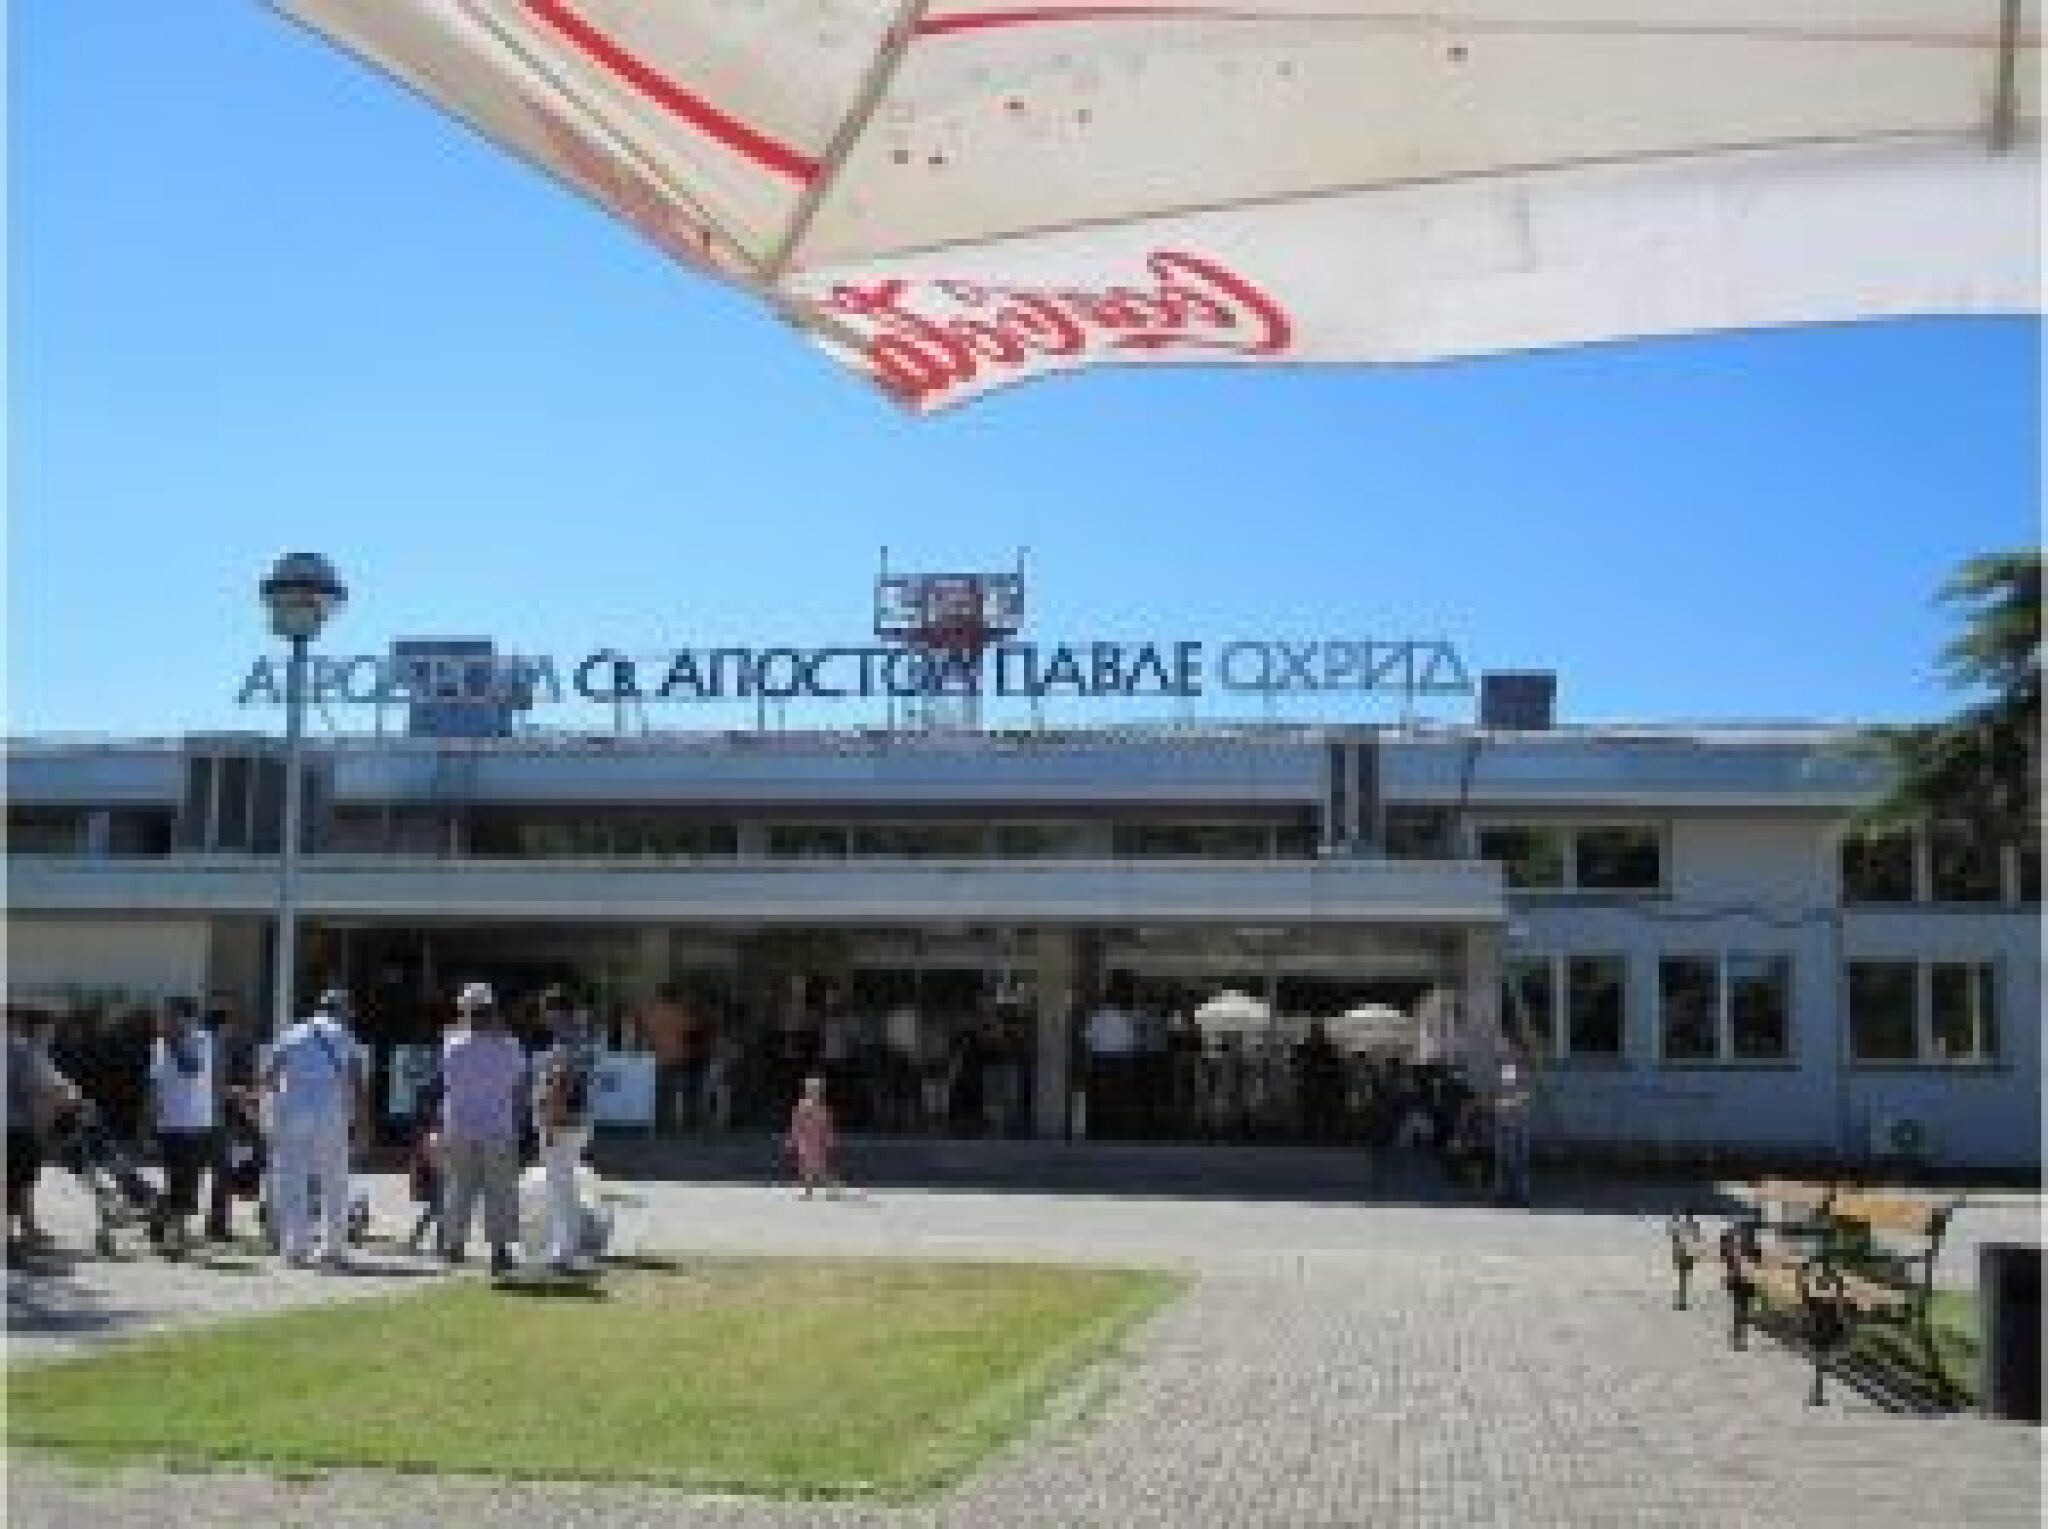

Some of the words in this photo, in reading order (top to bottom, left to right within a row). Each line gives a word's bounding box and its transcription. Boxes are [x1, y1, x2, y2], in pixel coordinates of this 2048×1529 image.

[656, 646, 980, 698] АПОСТОЛ
[996, 640, 1201, 698] ПАВЛЕ
[1219, 641, 1474, 692] ОХРИД
